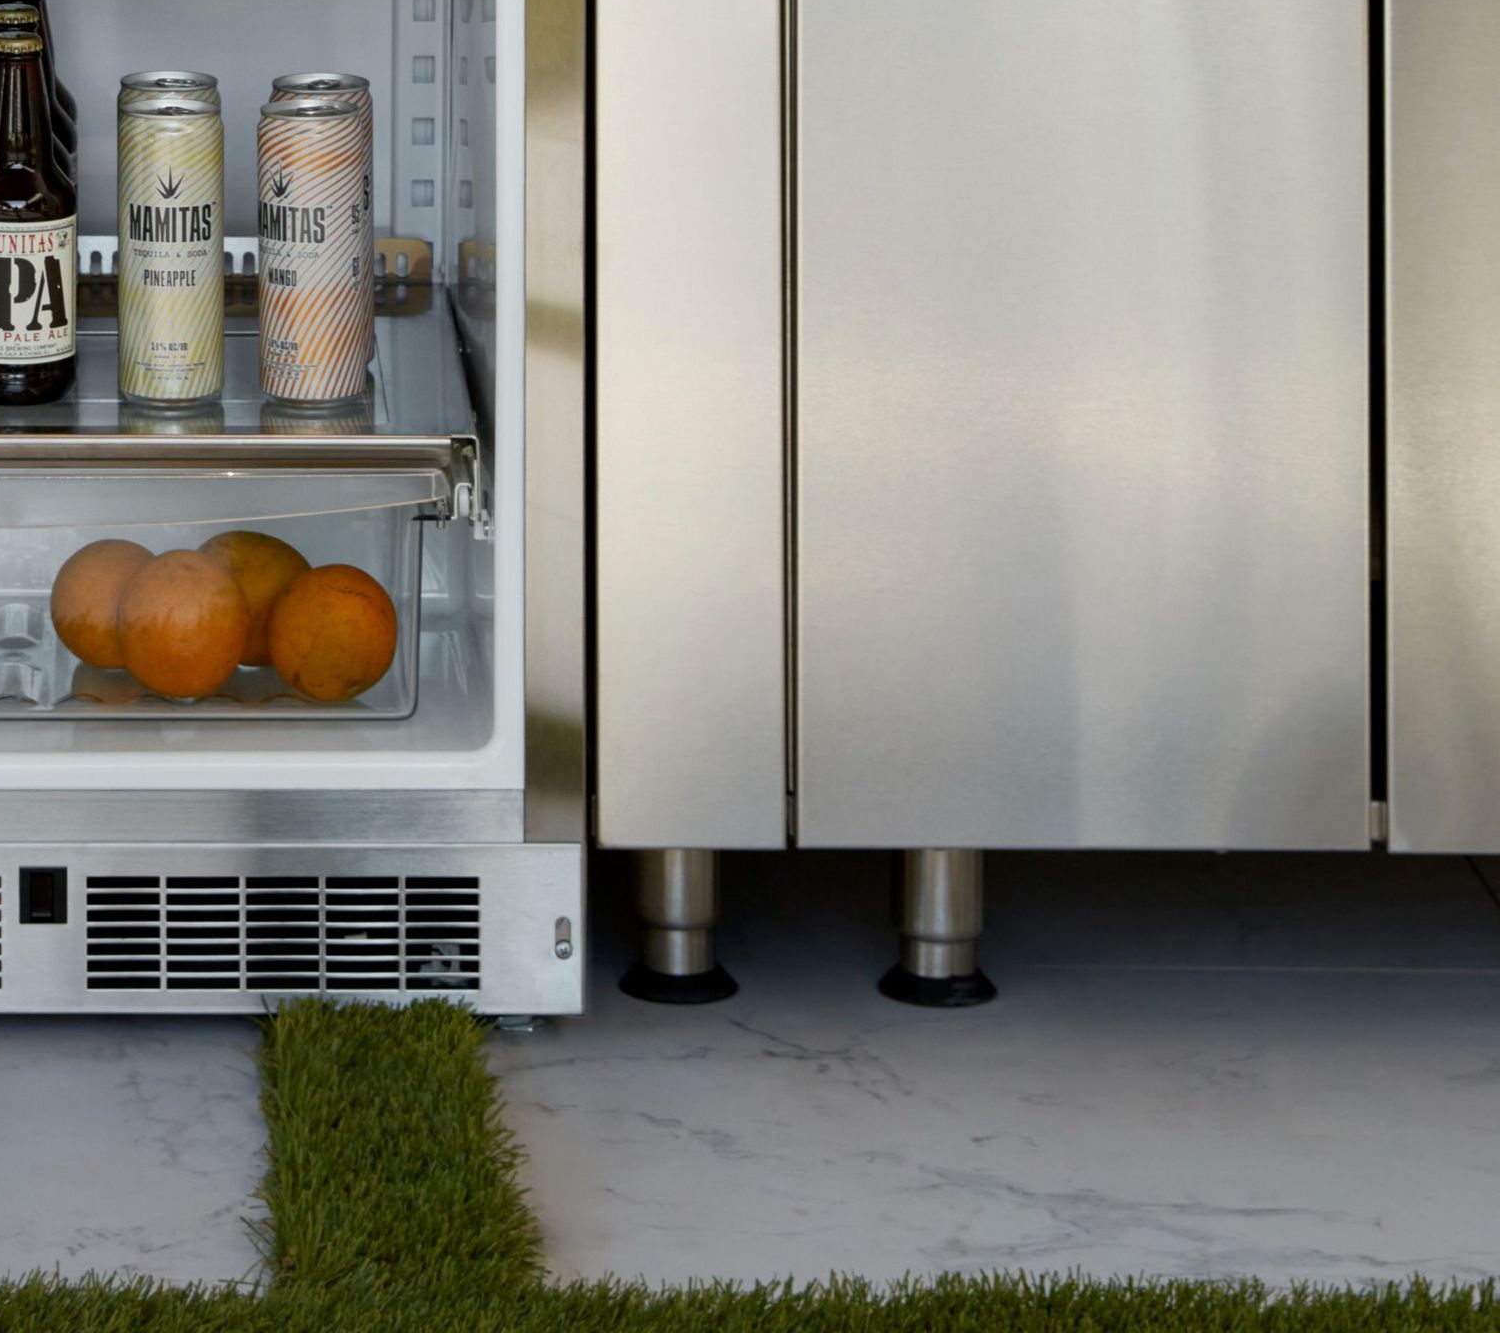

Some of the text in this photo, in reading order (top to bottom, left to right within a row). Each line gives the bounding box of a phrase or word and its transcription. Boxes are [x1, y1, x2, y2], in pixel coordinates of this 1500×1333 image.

[129, 202, 212, 243] MAMITAS
[259, 200, 325, 244] AMITAS
[143, 269, 197, 287] PINEAPPLE
[268, 266, 297, 287] MANGO
[3, 331, 41, 343] PALE
[49, 327, 69, 341] ALE
